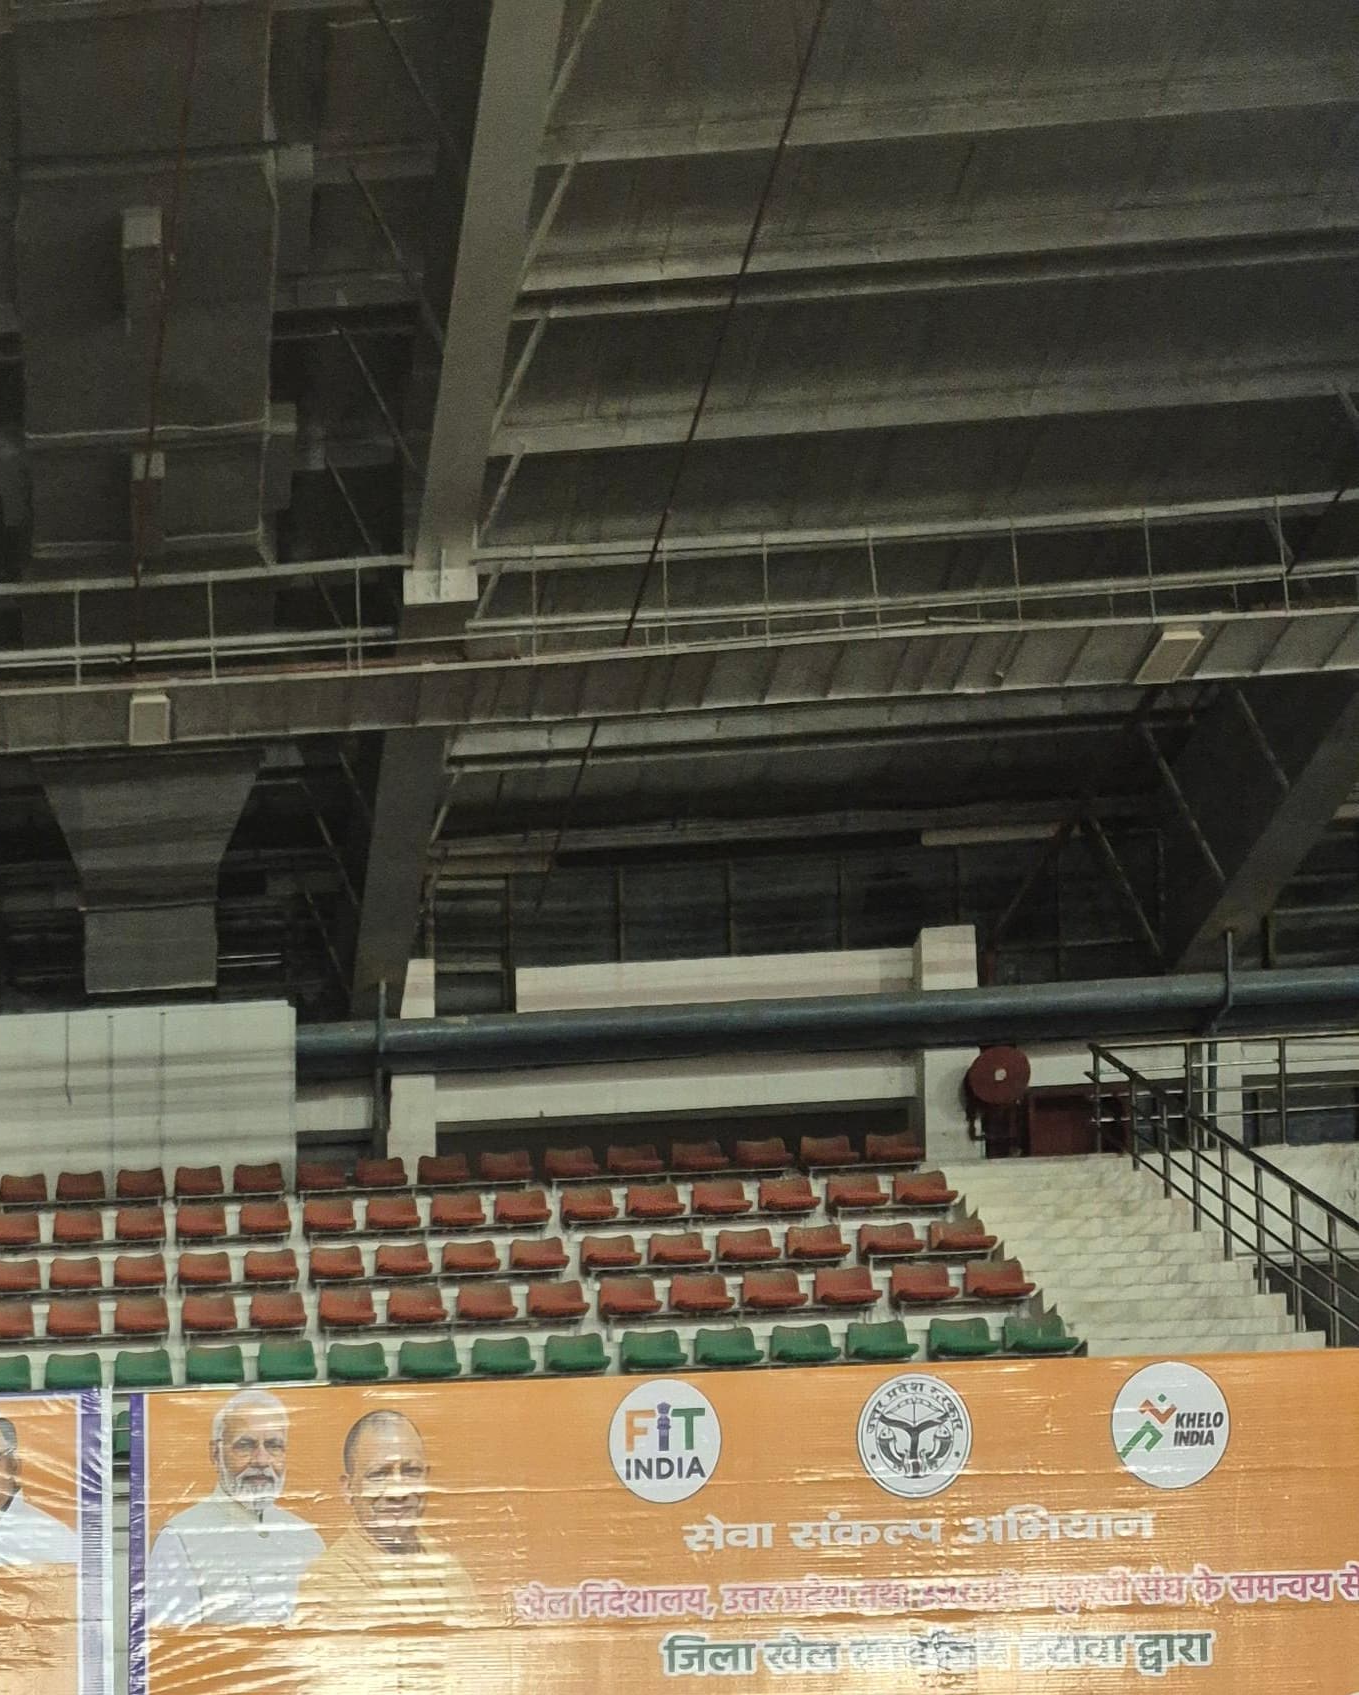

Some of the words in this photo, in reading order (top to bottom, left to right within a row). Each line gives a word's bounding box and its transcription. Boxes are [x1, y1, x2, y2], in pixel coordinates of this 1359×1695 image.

[1175, 1412, 1224, 1429] KHELO
[1173, 1430, 1215, 1447] INDIA
[625, 1457, 706, 1481] INDIA
[682, 1514, 776, 1552] सेवा
[788, 1511, 942, 1550] संकल्प
[956, 1504, 1155, 1545] अभियान
[517, 1583, 571, 1617] खेल
[578, 1581, 715, 1616] निदेशालय,
[722, 1585, 777, 1613] उत्तर
[1138, 1566, 1185, 1603] संघ
[1190, 1566, 1223, 1603] के
[1230, 1572, 1332, 1599] समन्वय
[663, 1634, 756, 1674] जिला
[765, 1632, 838, 1671] खेल
[1134, 1632, 1212, 1672] द्वारा
